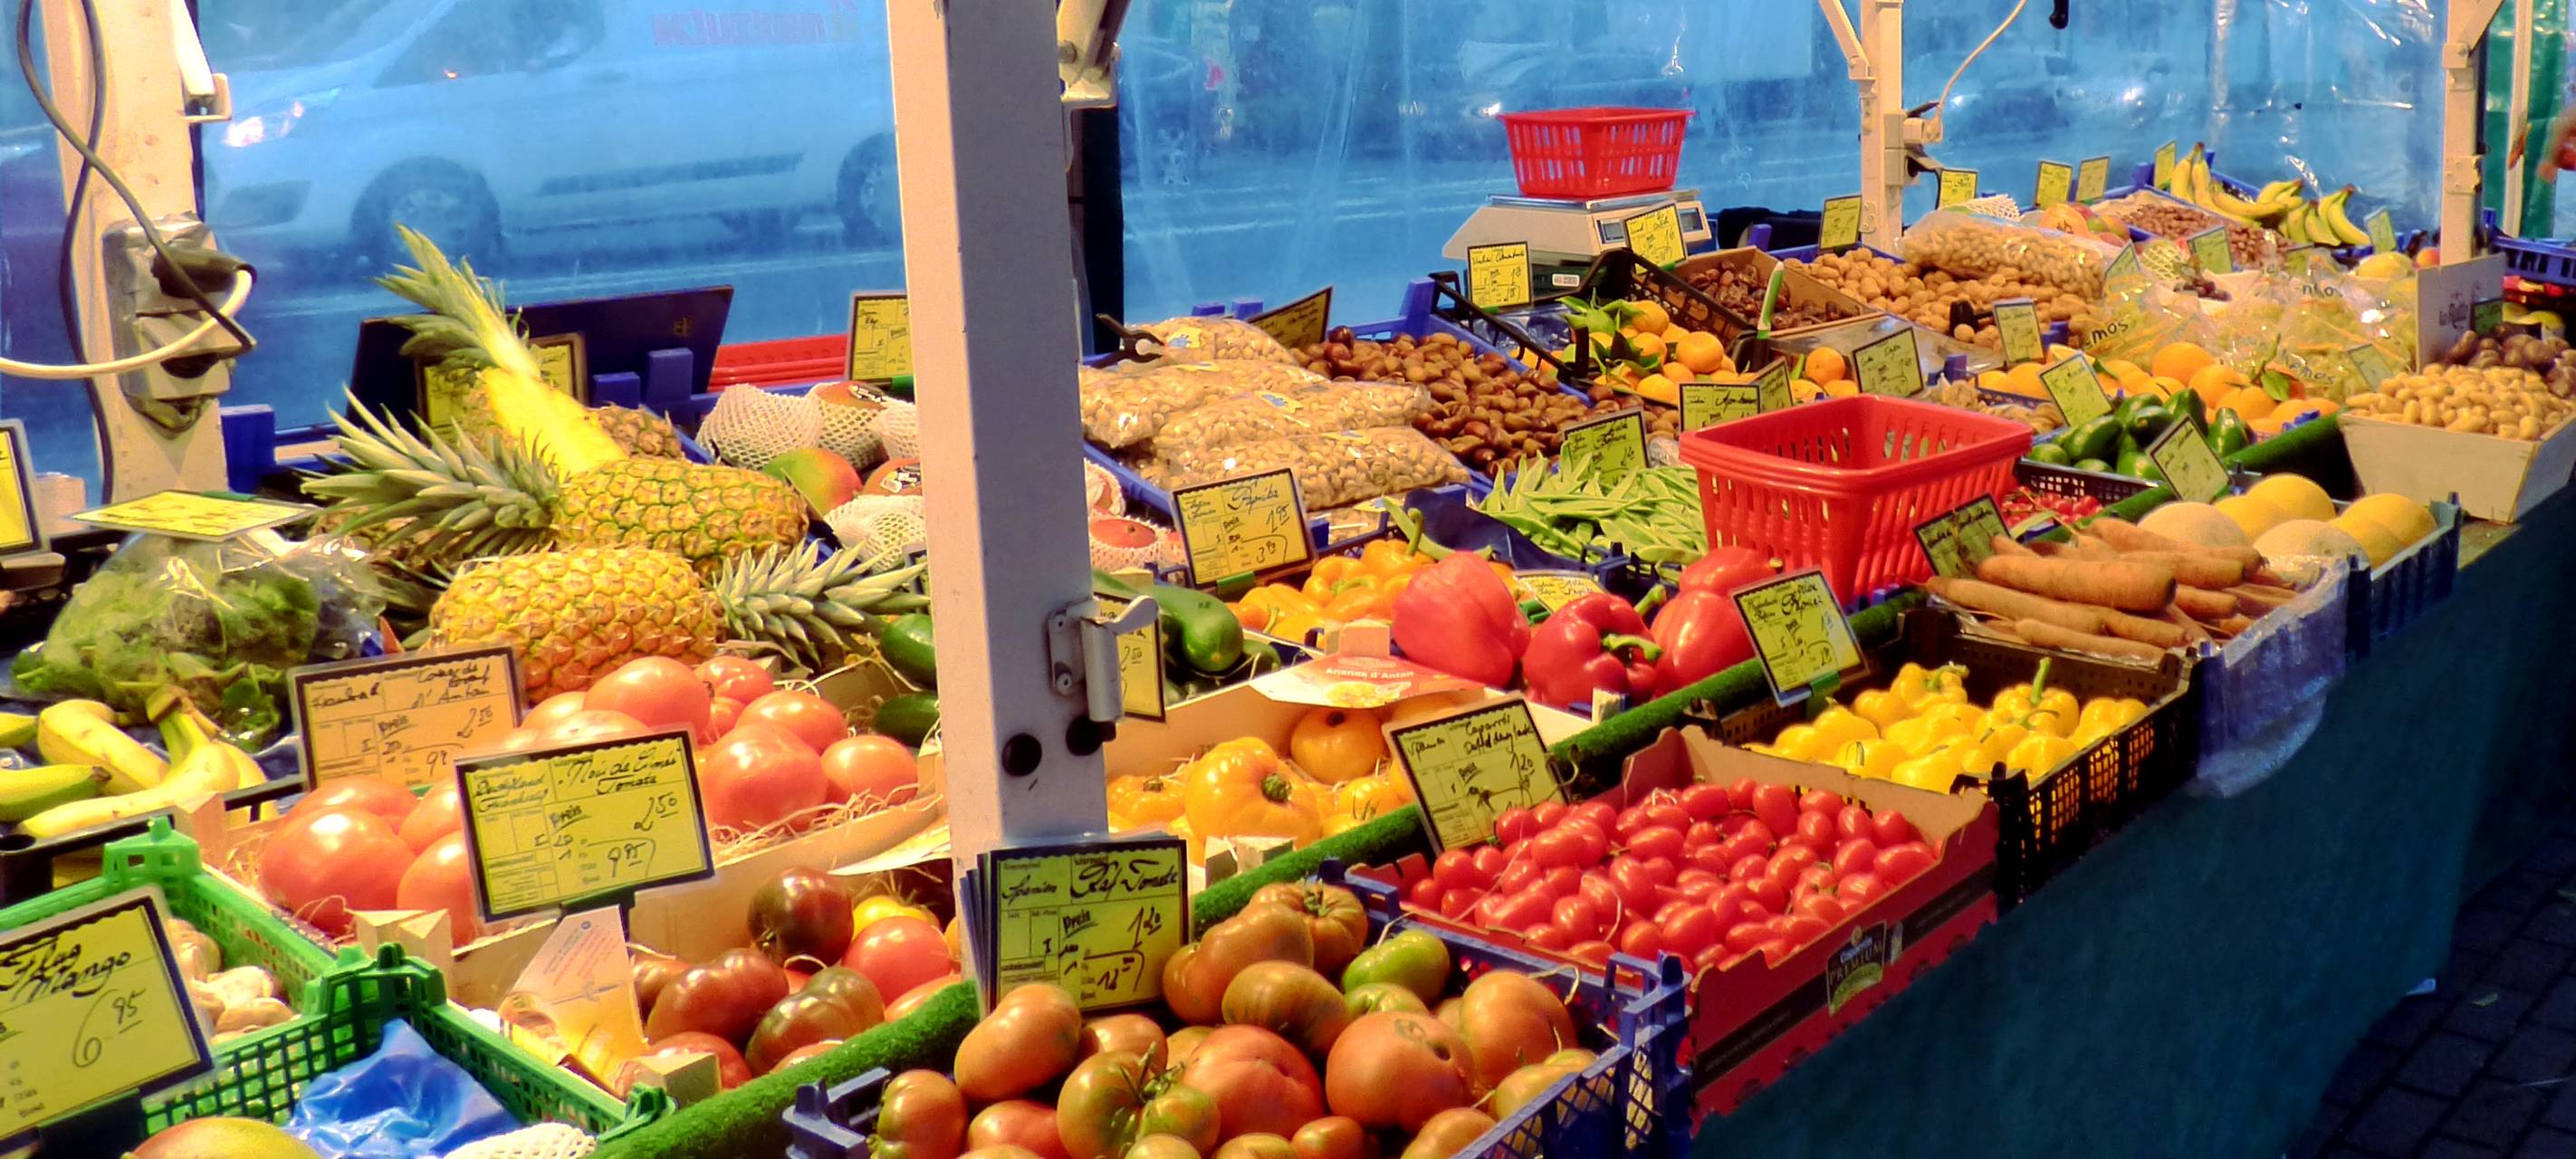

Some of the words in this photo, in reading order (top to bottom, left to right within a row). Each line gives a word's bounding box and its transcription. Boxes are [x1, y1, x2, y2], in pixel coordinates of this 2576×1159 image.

[1326, 667, 1367, 678] Ananas
[1370, 671, 1415, 680] d'Antan
[1062, 909, 1091, 935] Preis
[11, 952, 131, 1003] Mango
